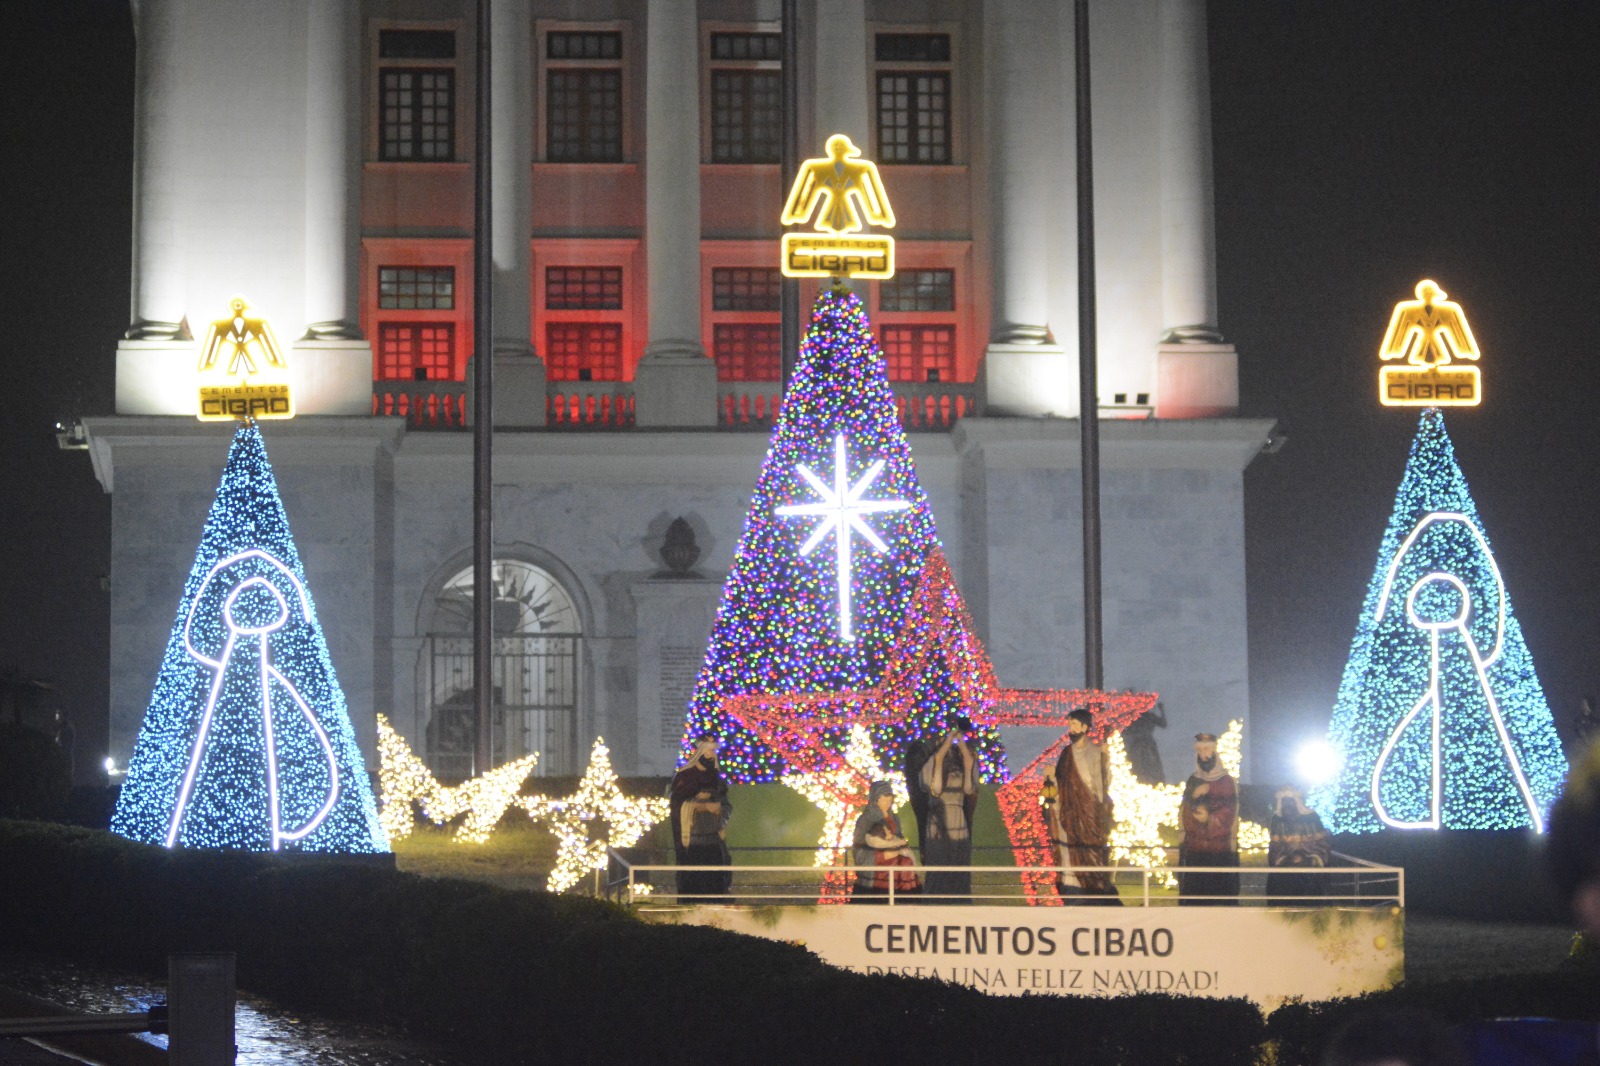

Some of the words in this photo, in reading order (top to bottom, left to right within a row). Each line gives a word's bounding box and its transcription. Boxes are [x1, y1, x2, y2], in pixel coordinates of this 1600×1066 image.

[200, 386, 289, 395] CEMENTOS
[864, 923, 1057, 956] CEMENTOS
[1071, 927, 1175, 958] CIBAO
[952, 967, 1007, 988] UNA
[1017, 969, 1083, 989] FELIZ
[1093, 970, 1219, 991] NAVIDAD!
